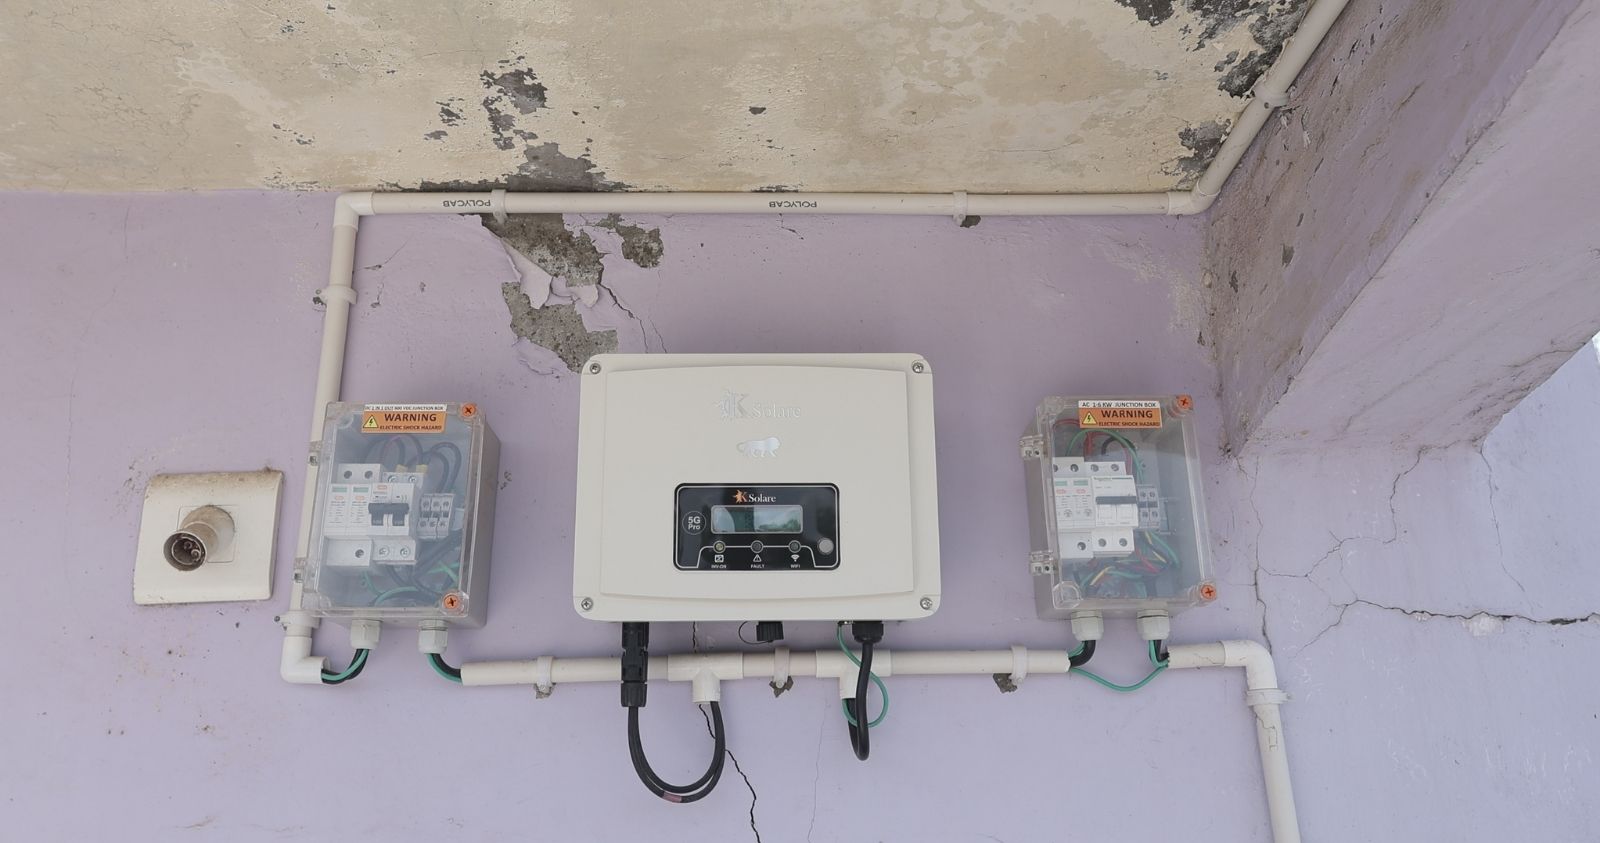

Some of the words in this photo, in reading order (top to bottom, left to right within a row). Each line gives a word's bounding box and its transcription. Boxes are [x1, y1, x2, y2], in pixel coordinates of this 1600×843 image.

[442, 199, 491, 207] POLYCAB
[768, 200, 817, 208] POLYCAB
[752, 401, 801, 418] Solare
[384, 413, 437, 421] WARNING
[1101, 410, 1153, 418] WARNING
[748, 493, 777, 503] Solare
[687, 516, 701, 524] 5G
